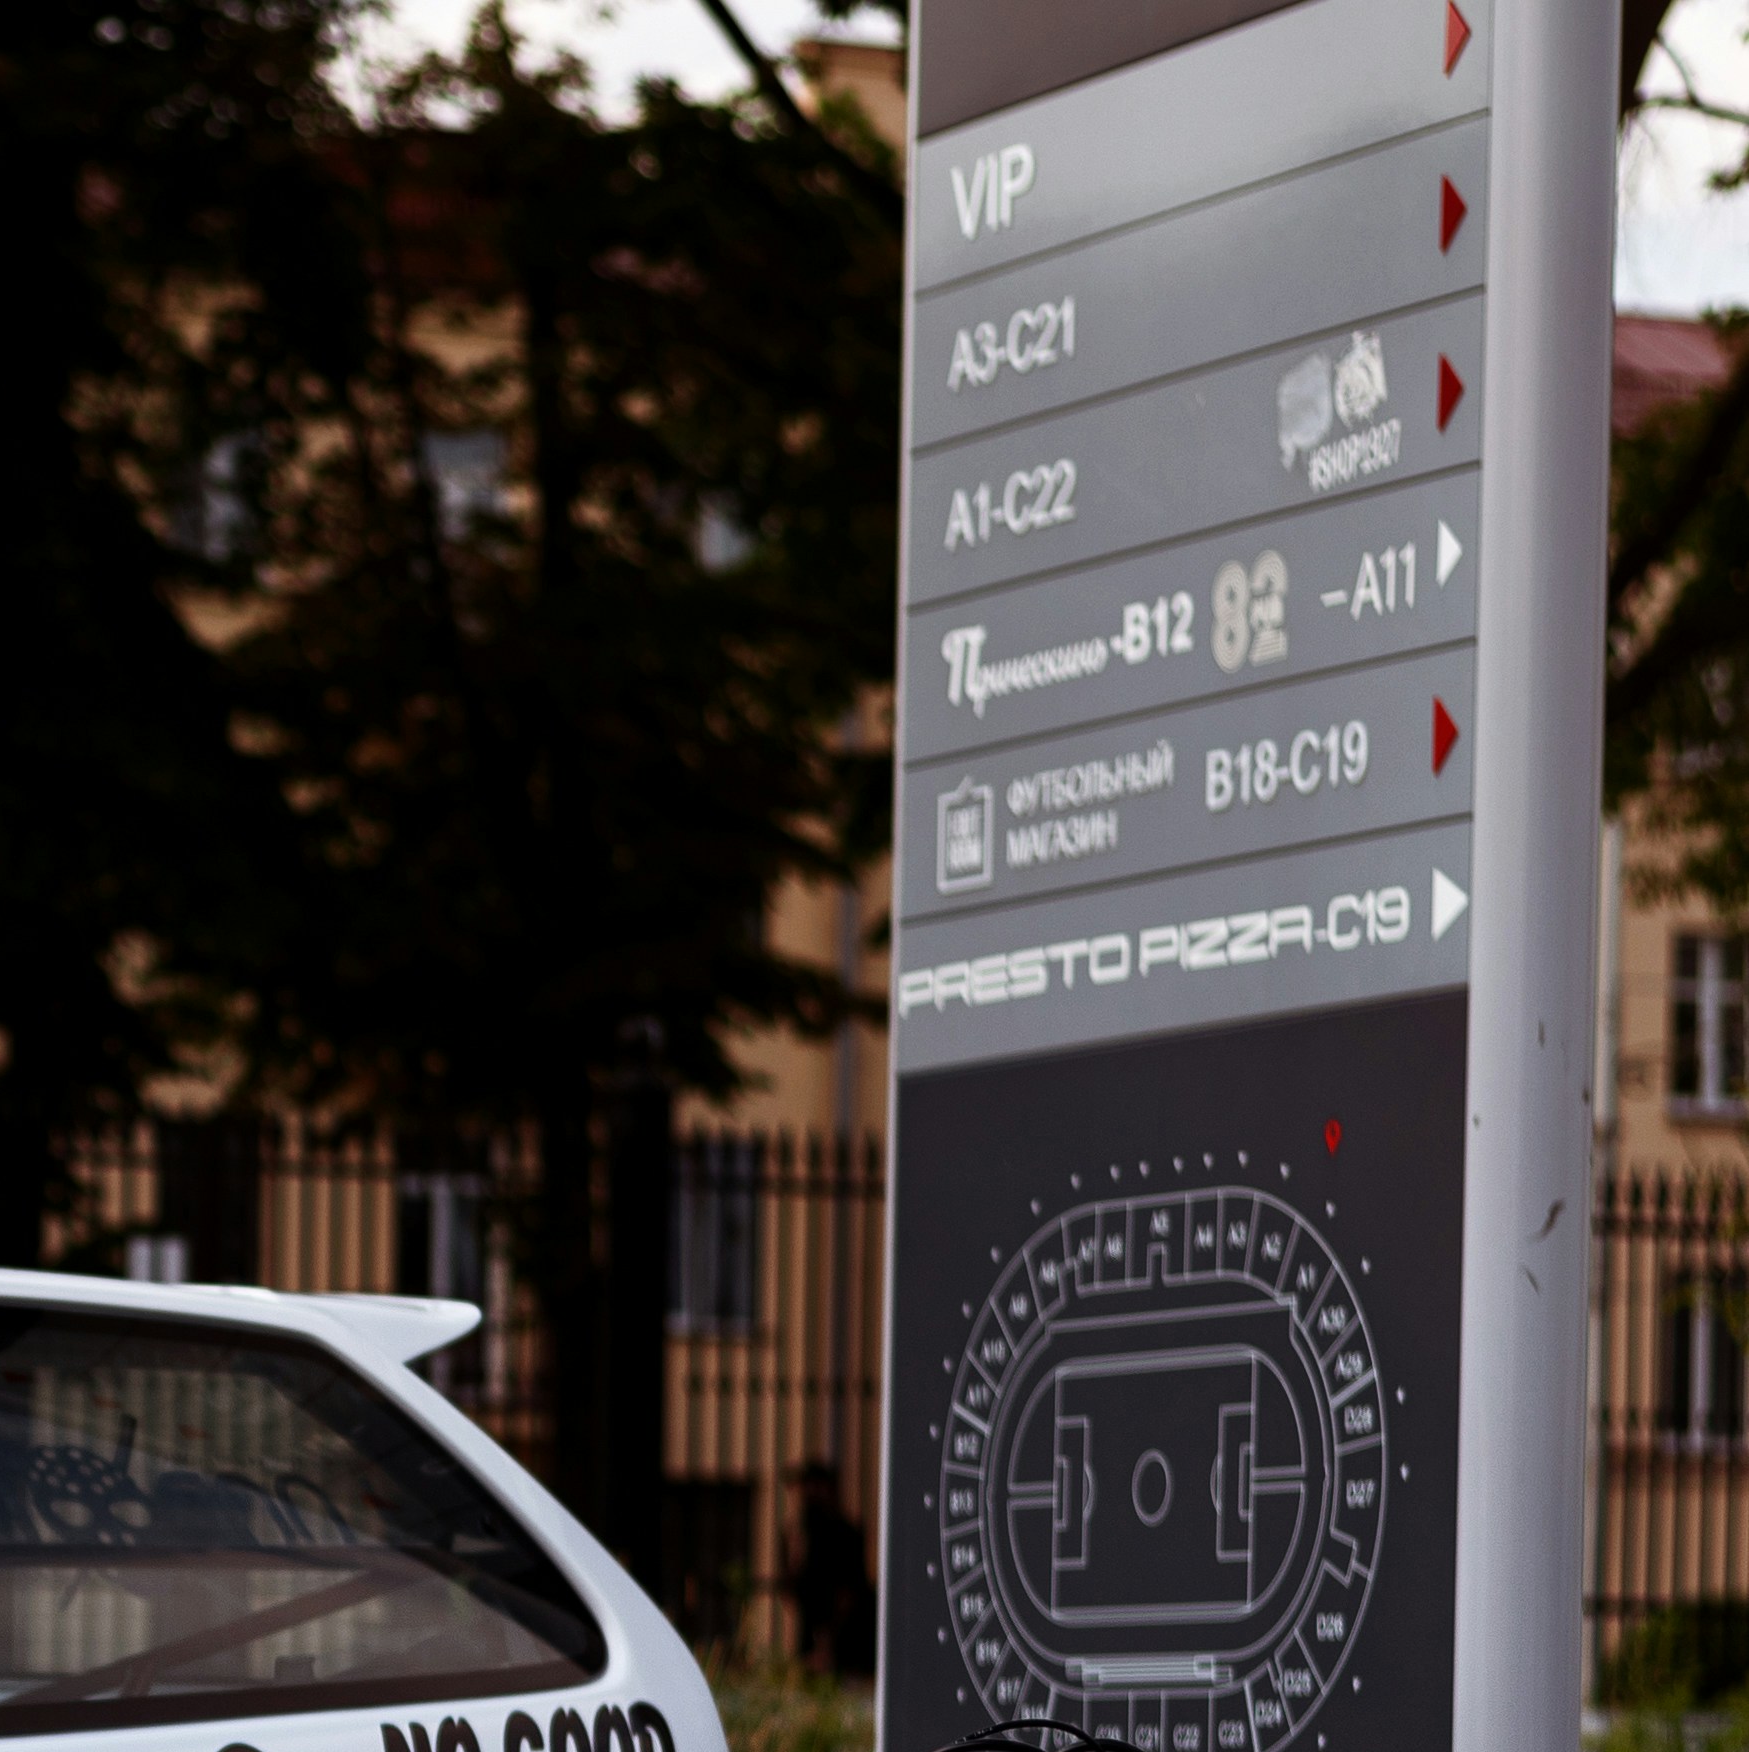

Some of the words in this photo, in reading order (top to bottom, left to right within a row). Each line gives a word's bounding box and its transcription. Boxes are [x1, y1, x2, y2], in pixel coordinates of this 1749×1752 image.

[949, 143, 1036, 240] VIP
[947, 296, 1078, 392] A3-C21
[944, 459, 1078, 553] A1-C22
[1205, 720, 1368, 813] B18-C19
[899, 934, 1130, 1018] PRESTO
